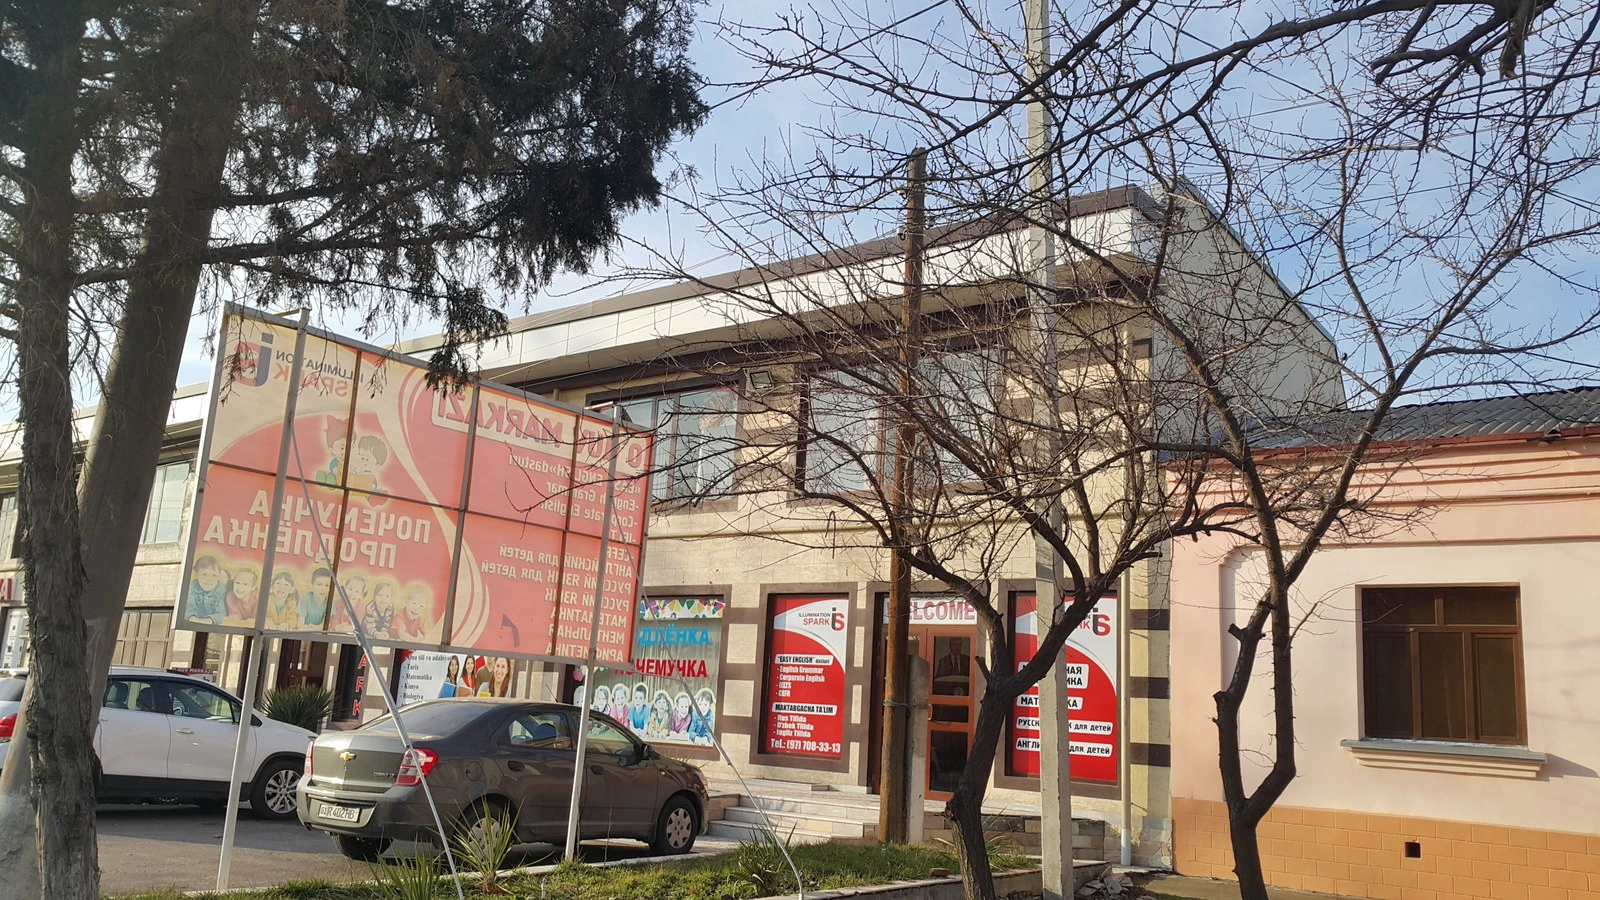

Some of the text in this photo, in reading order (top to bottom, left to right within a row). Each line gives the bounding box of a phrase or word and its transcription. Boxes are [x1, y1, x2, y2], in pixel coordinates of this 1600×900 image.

[803, 617, 830, 626] SPARK
[405, 673, 432, 681] Matematika
[1074, 723, 1088, 731] для
[1089, 724, 1111, 732] детей
[786, 739, 802, 750] (97)
[802, 740, 842, 754] 708-33-13
[1069, 744, 1110, 755] для детей
